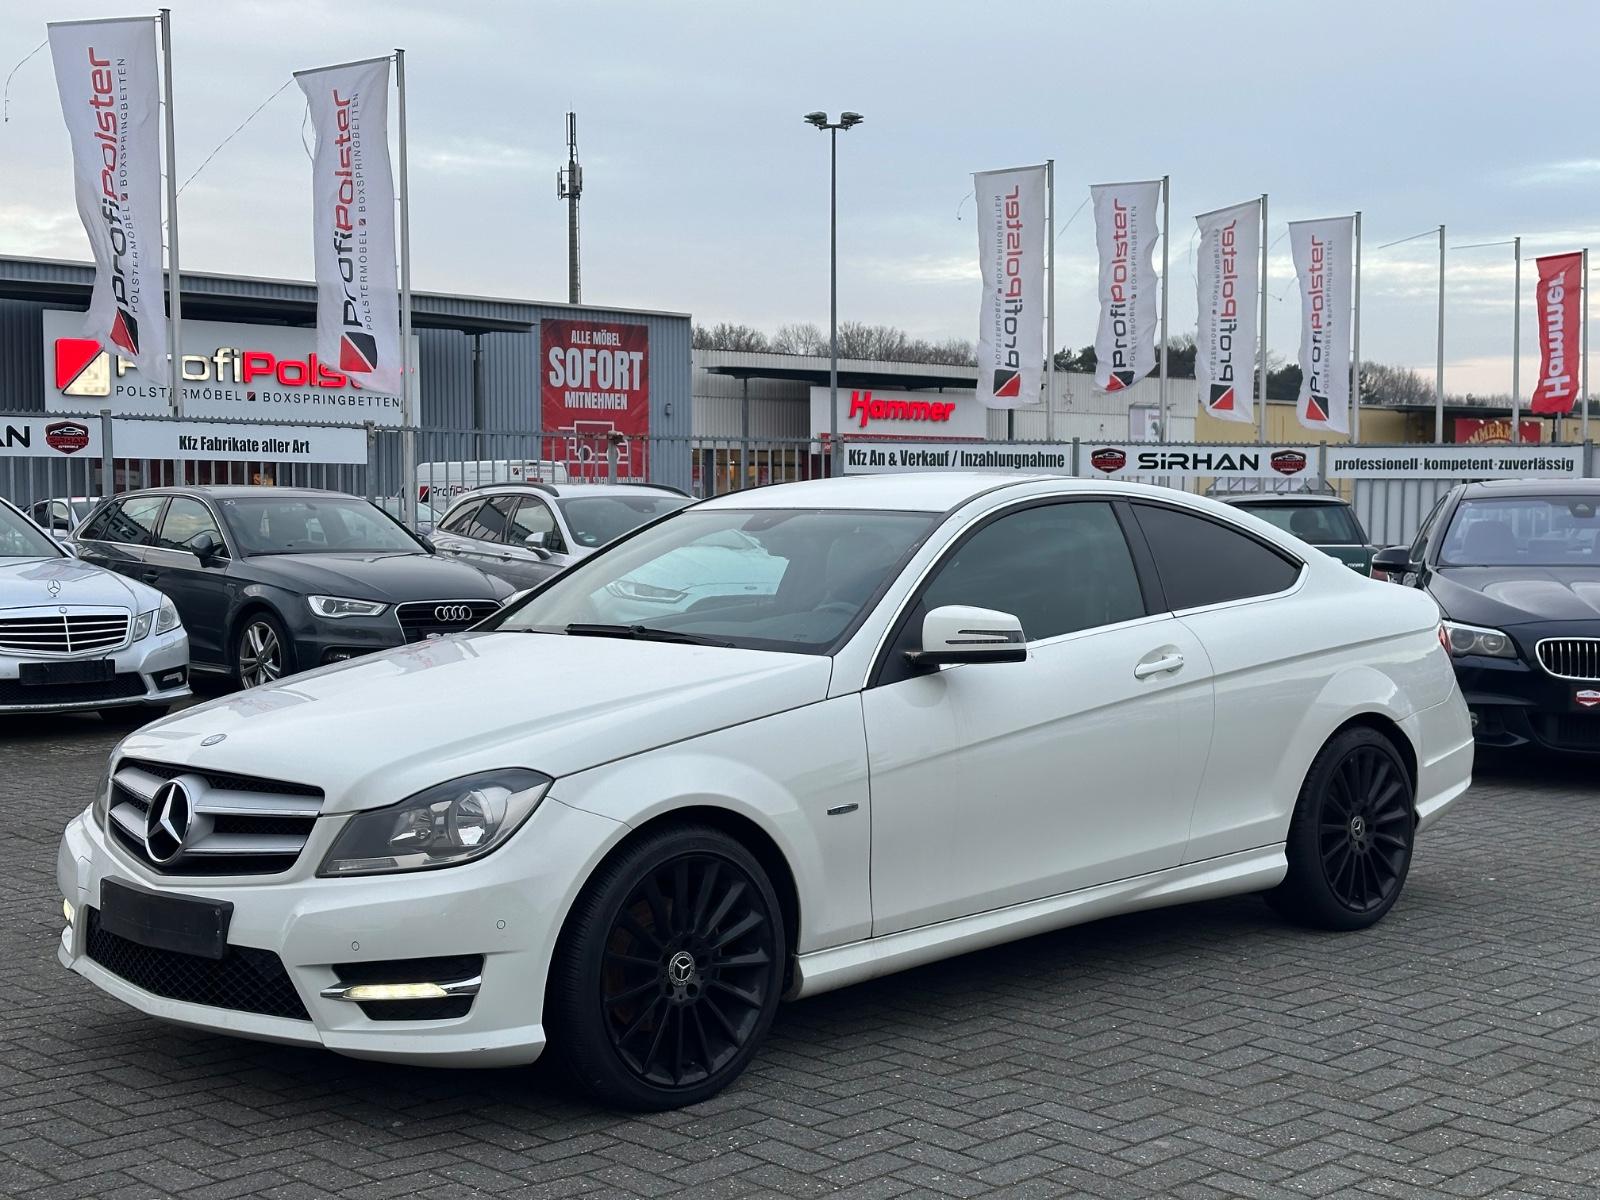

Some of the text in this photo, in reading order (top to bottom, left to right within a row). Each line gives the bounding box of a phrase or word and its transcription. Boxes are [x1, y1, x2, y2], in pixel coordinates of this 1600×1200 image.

[117, 58, 128, 187] BOXSPRINGBETTEN
[351, 93, 373, 330] POLSTERMÖBEL BOXSPRINGBETTEN
[571, 329, 621, 346] ALLE MÖBEL
[1543, 271, 1570, 398] Hammer
[549, 347, 644, 391] SOFORT
[263, 392, 400, 407] BOXSPRINGBETTEN
[564, 391, 628, 410] MITNEHMEN
[848, 390, 956, 428] Hammer
[179, 435, 311, 454] Kfz Fabrikate aller Art
[848, 449, 1065, 469] Kfz An & Verkauf / Inzahlungnahme
[1334, 457, 1574, 472] professionell kompetent zuverlässig
